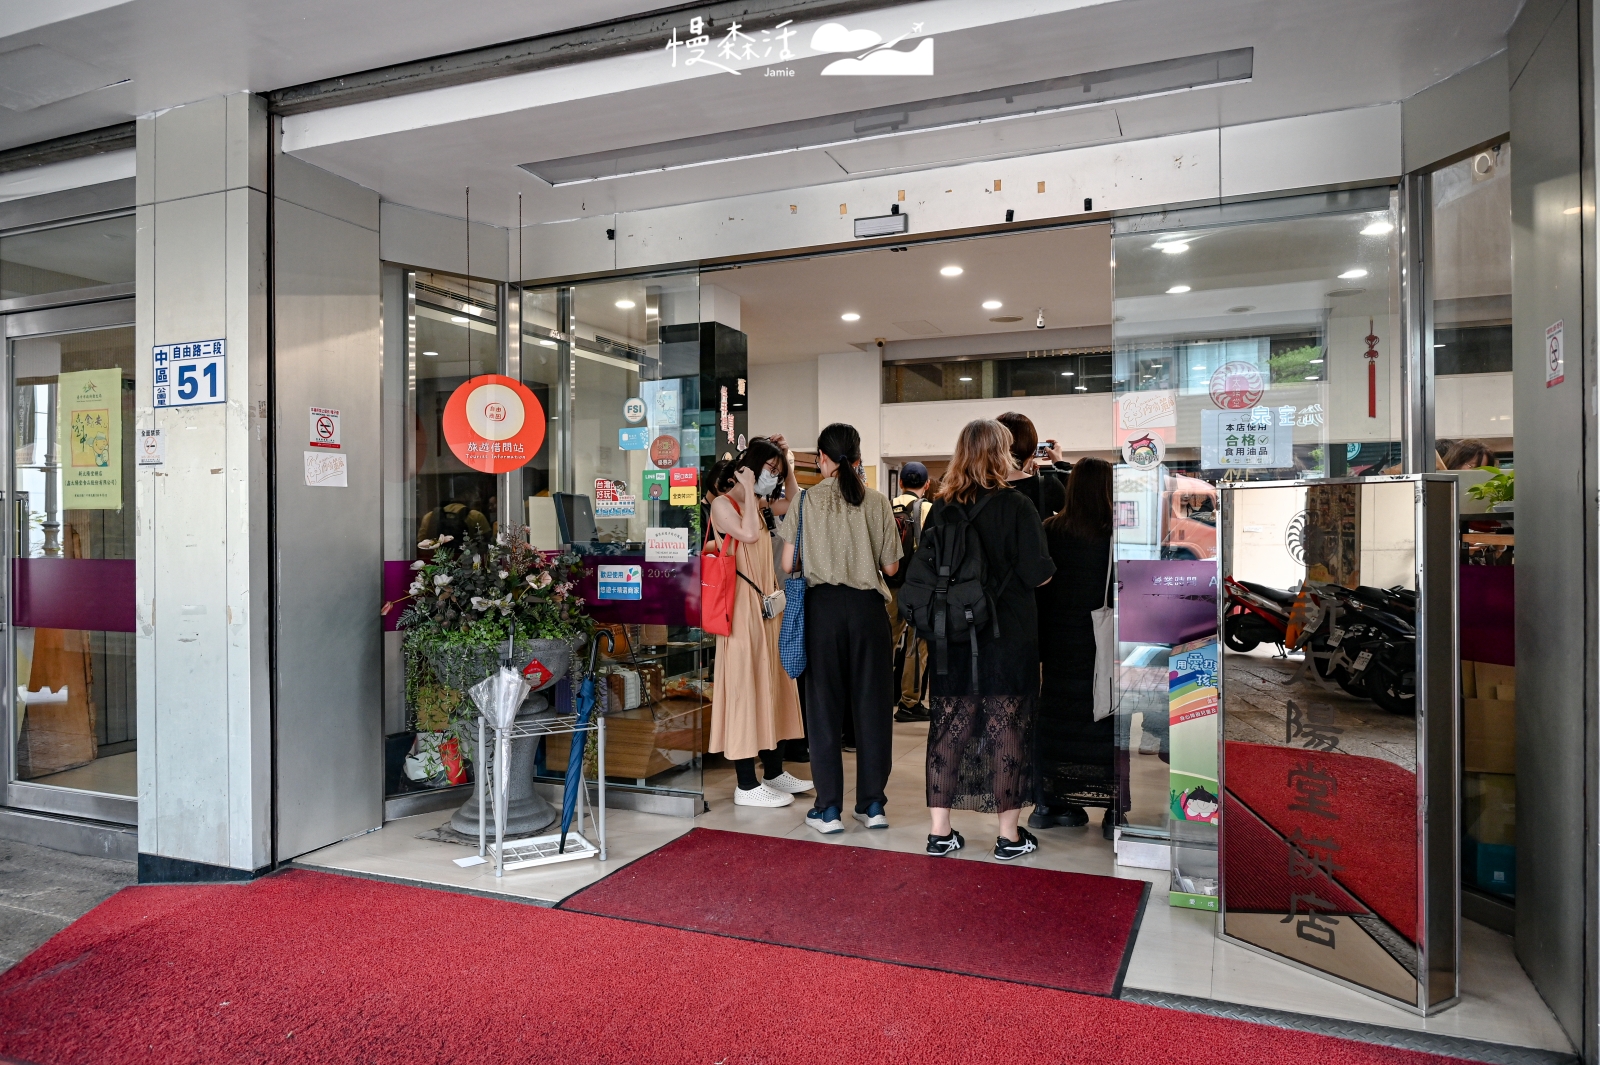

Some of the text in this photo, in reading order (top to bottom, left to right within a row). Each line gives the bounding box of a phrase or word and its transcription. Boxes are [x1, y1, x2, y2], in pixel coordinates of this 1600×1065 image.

[173, 342, 222, 359] 自由路二段
[155, 350, 168, 384] 中區
[177, 363, 217, 400] 51
[627, 405, 642, 413] FSI
[1225, 423, 1267, 431] 本店使用
[1225, 434, 1256, 447] 合格
[467, 442, 524, 453] 旅遊借問站
[1225, 447, 1268, 456] 食用油品
[648, 538, 686, 549] Taiwan
[1152, 576, 1197, 586] 營業時間
